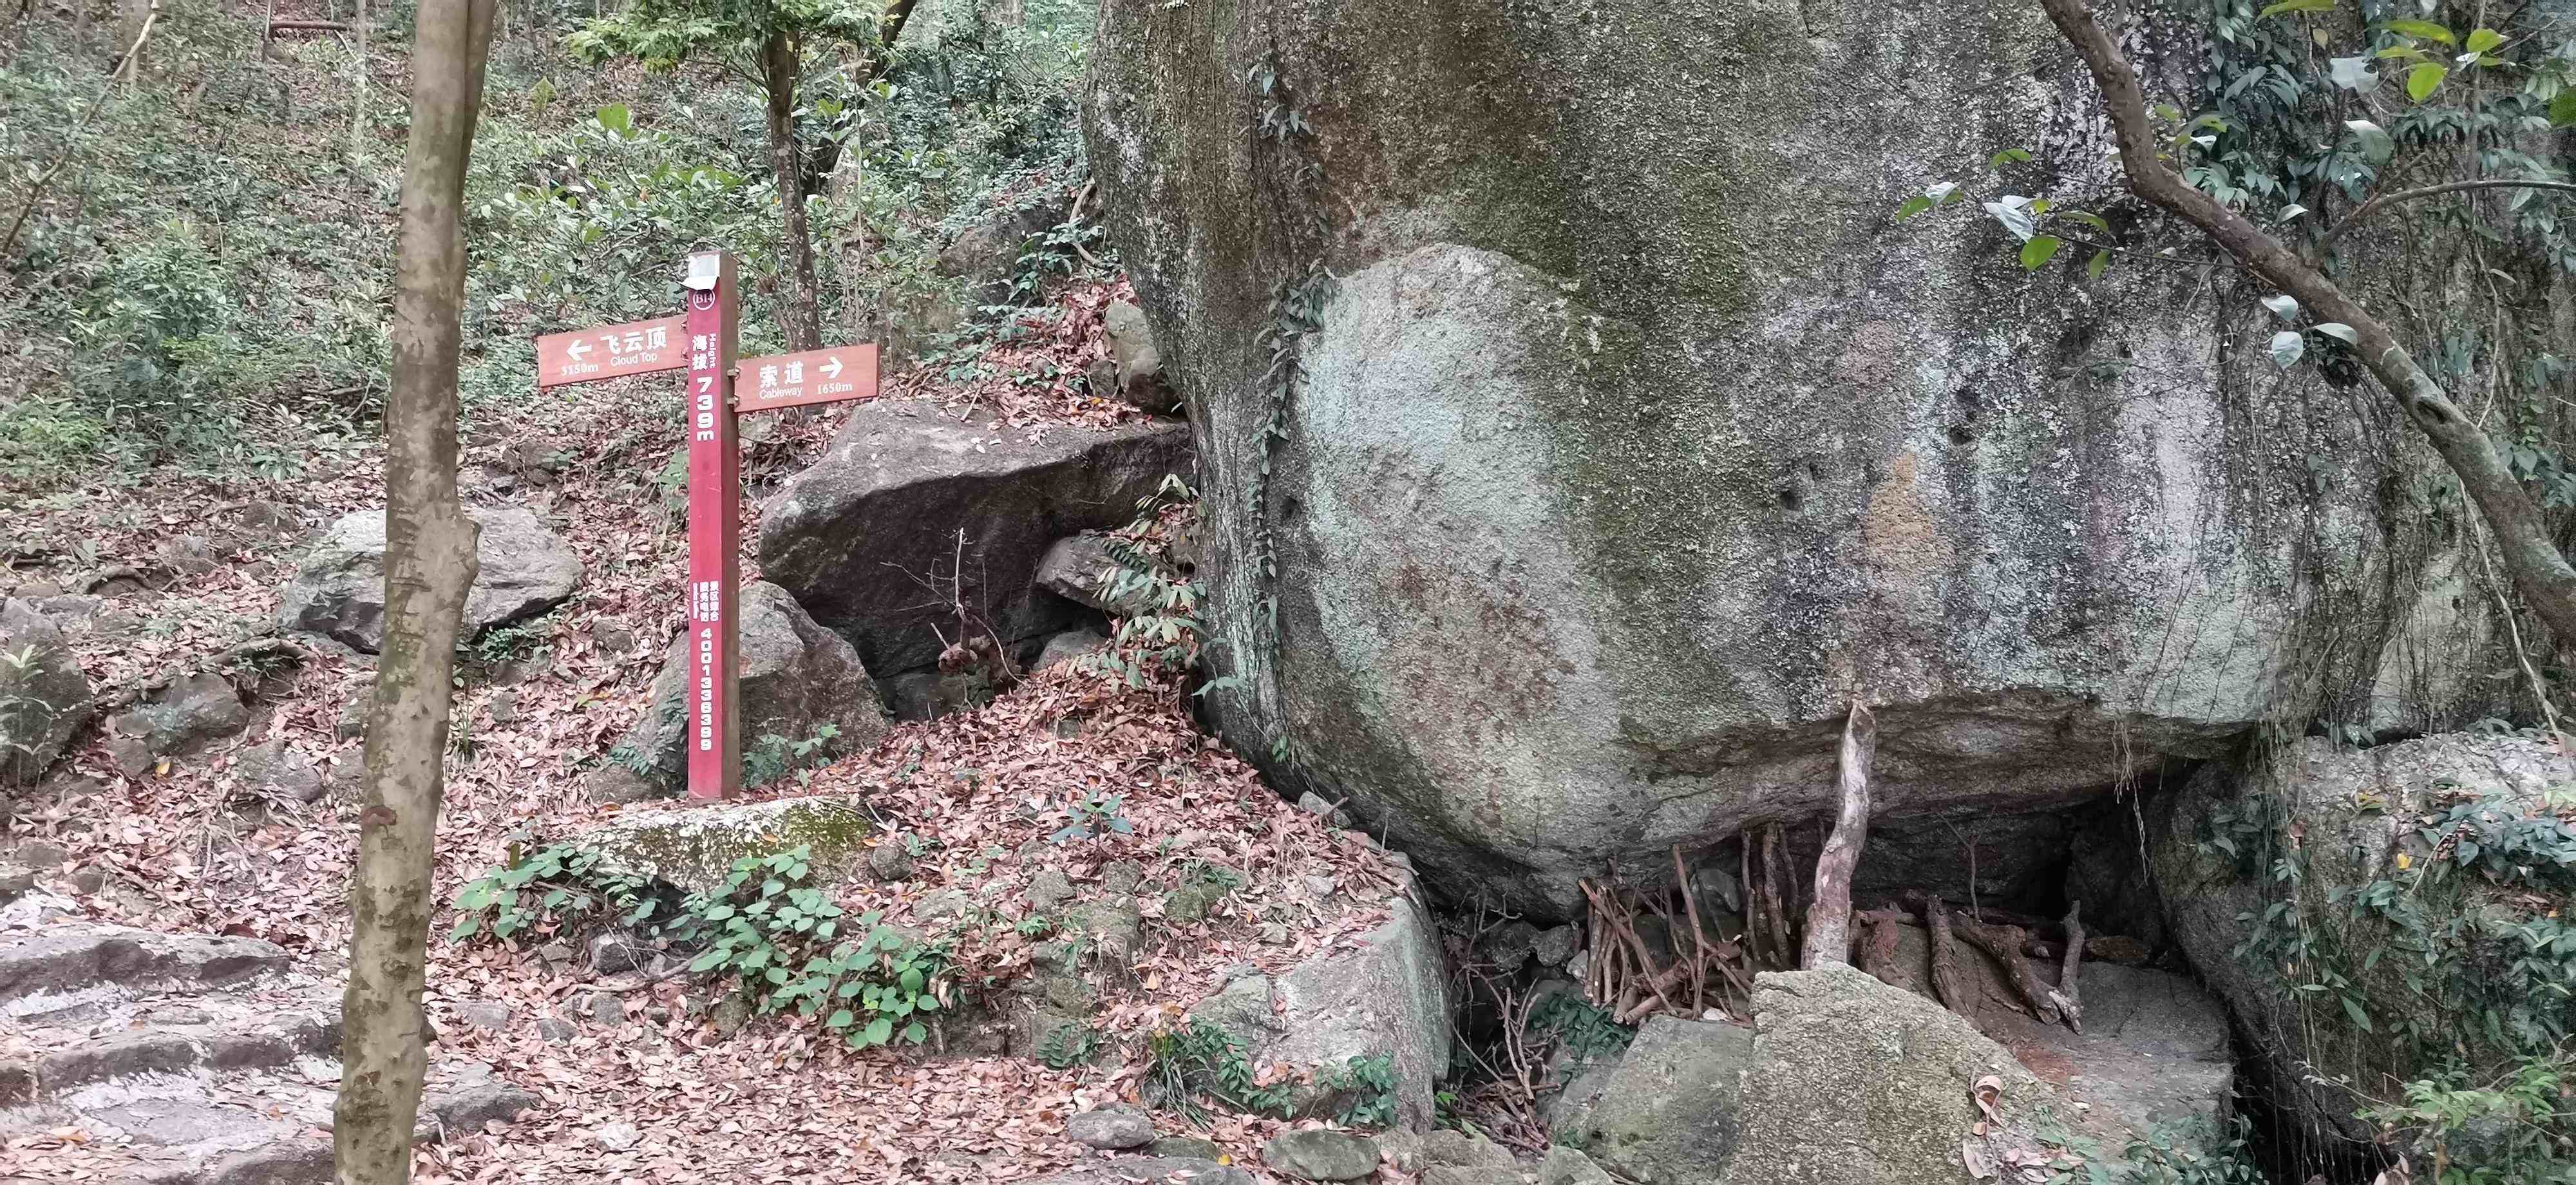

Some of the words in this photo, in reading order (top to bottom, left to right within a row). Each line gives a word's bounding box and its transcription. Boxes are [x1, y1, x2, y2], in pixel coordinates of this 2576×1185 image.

[696, 293, 712, 303] B14
[600, 327, 667, 354] 飞云顶
[692, 334, 707, 370] 海拔
[611, 352, 638, 366] Cloud
[640, 351, 658, 363] Top
[759, 361, 804, 388] 索道
[759, 386, 803, 400] Cableway
[817, 382, 853, 395] 1650m
[696, 376, 715, 442] 739m
[701, 627, 712, 750] 4001336399
